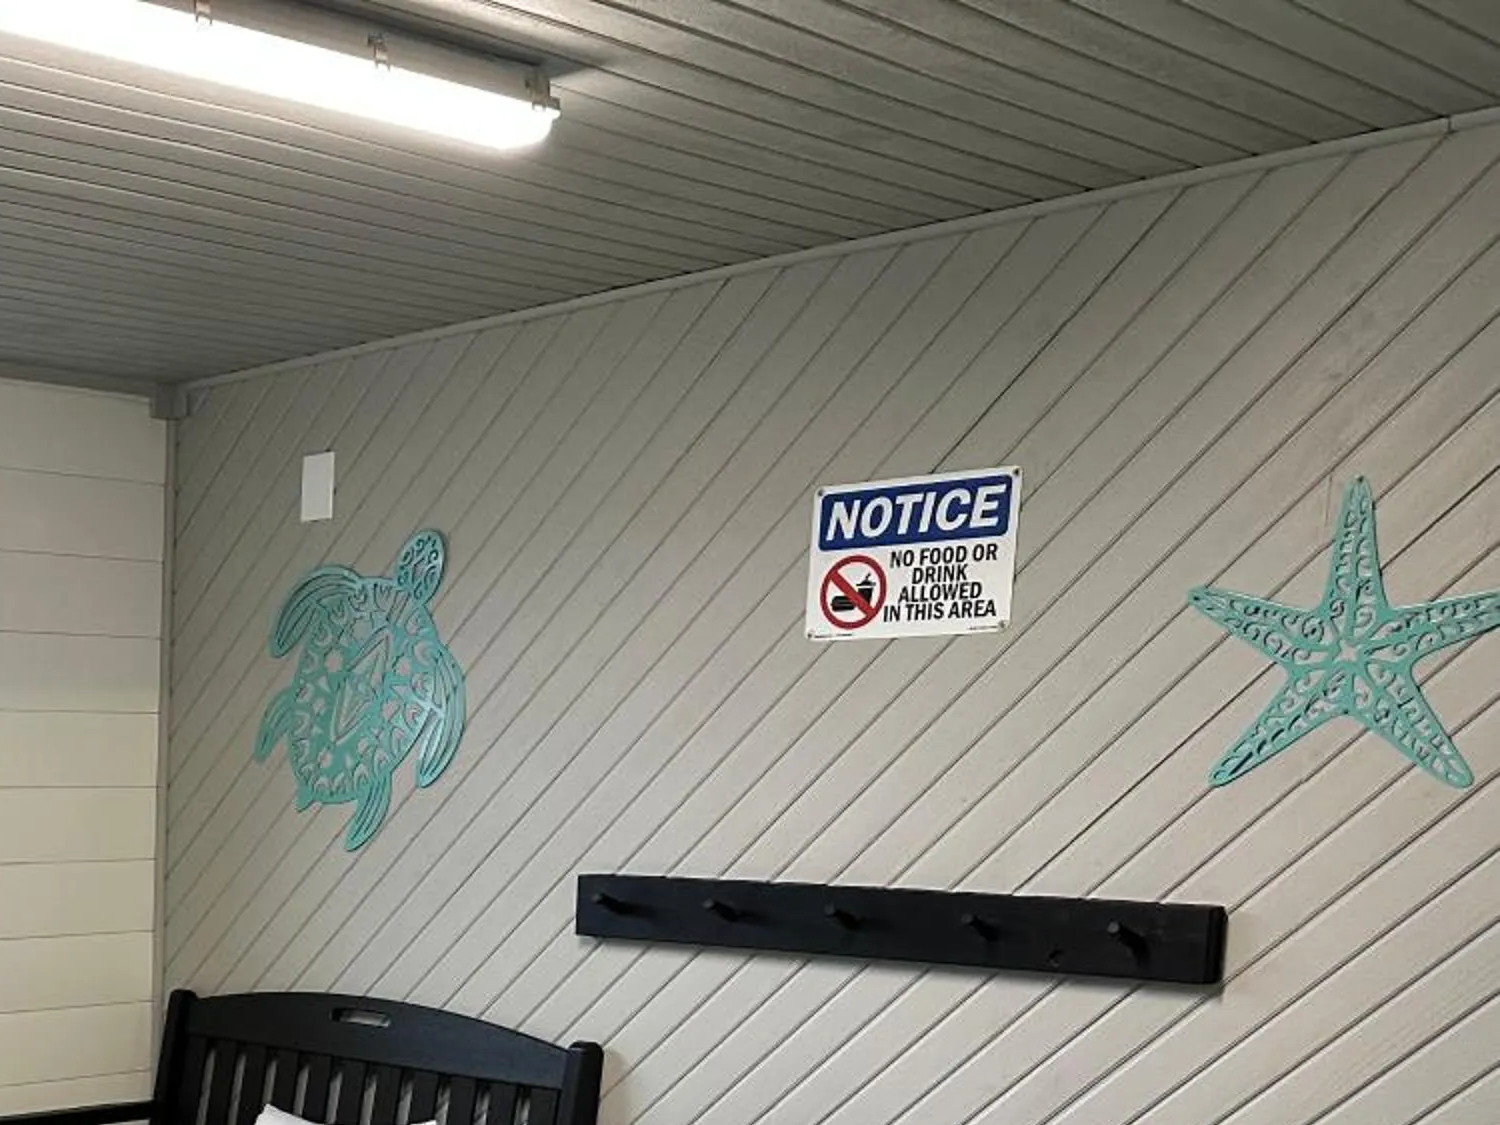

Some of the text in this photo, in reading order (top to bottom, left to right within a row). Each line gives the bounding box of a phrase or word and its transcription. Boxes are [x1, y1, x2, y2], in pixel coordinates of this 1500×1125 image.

[826, 484, 1006, 541] NOTICE
[890, 543, 998, 568] NO FOOD OR
[912, 564, 967, 585] DRINK
[898, 582, 982, 603] ALLOWED
[884, 600, 996, 622] IN THIS AREA
